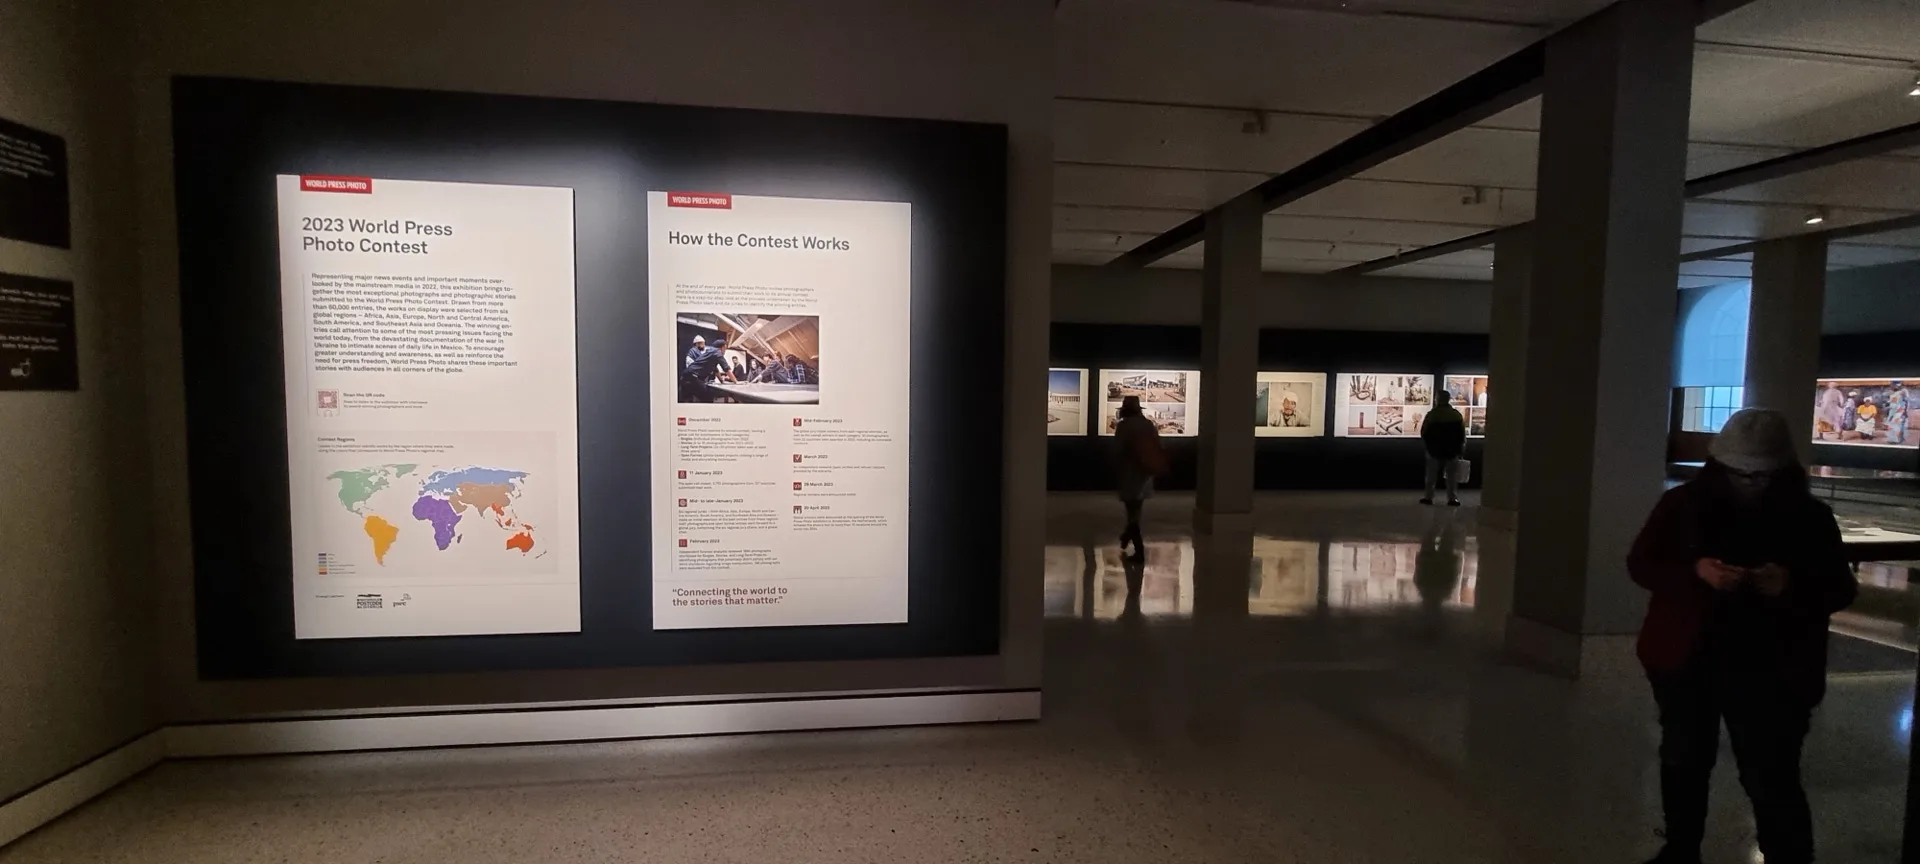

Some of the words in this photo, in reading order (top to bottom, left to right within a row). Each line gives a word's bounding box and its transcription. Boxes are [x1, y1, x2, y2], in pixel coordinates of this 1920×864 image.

[306, 180, 326, 188] WORLD
[328, 180, 346, 189] PRESS
[347, 181, 366, 190] PHOTO
[302, 217, 344, 232] 2023
[349, 219, 399, 234] World
[405, 221, 452, 236] Press
[303, 237, 355, 252] Photo
[360, 238, 428, 254] Contest
[669, 231, 703, 245] How
[707, 232, 732, 246] the
[738, 234, 798, 248] Contest
[802, 236, 849, 250] Works
[312, 273, 353, 281] Representing
[673, 588, 730, 597] “Connecting
[747, 596, 783, 605] matter.”
